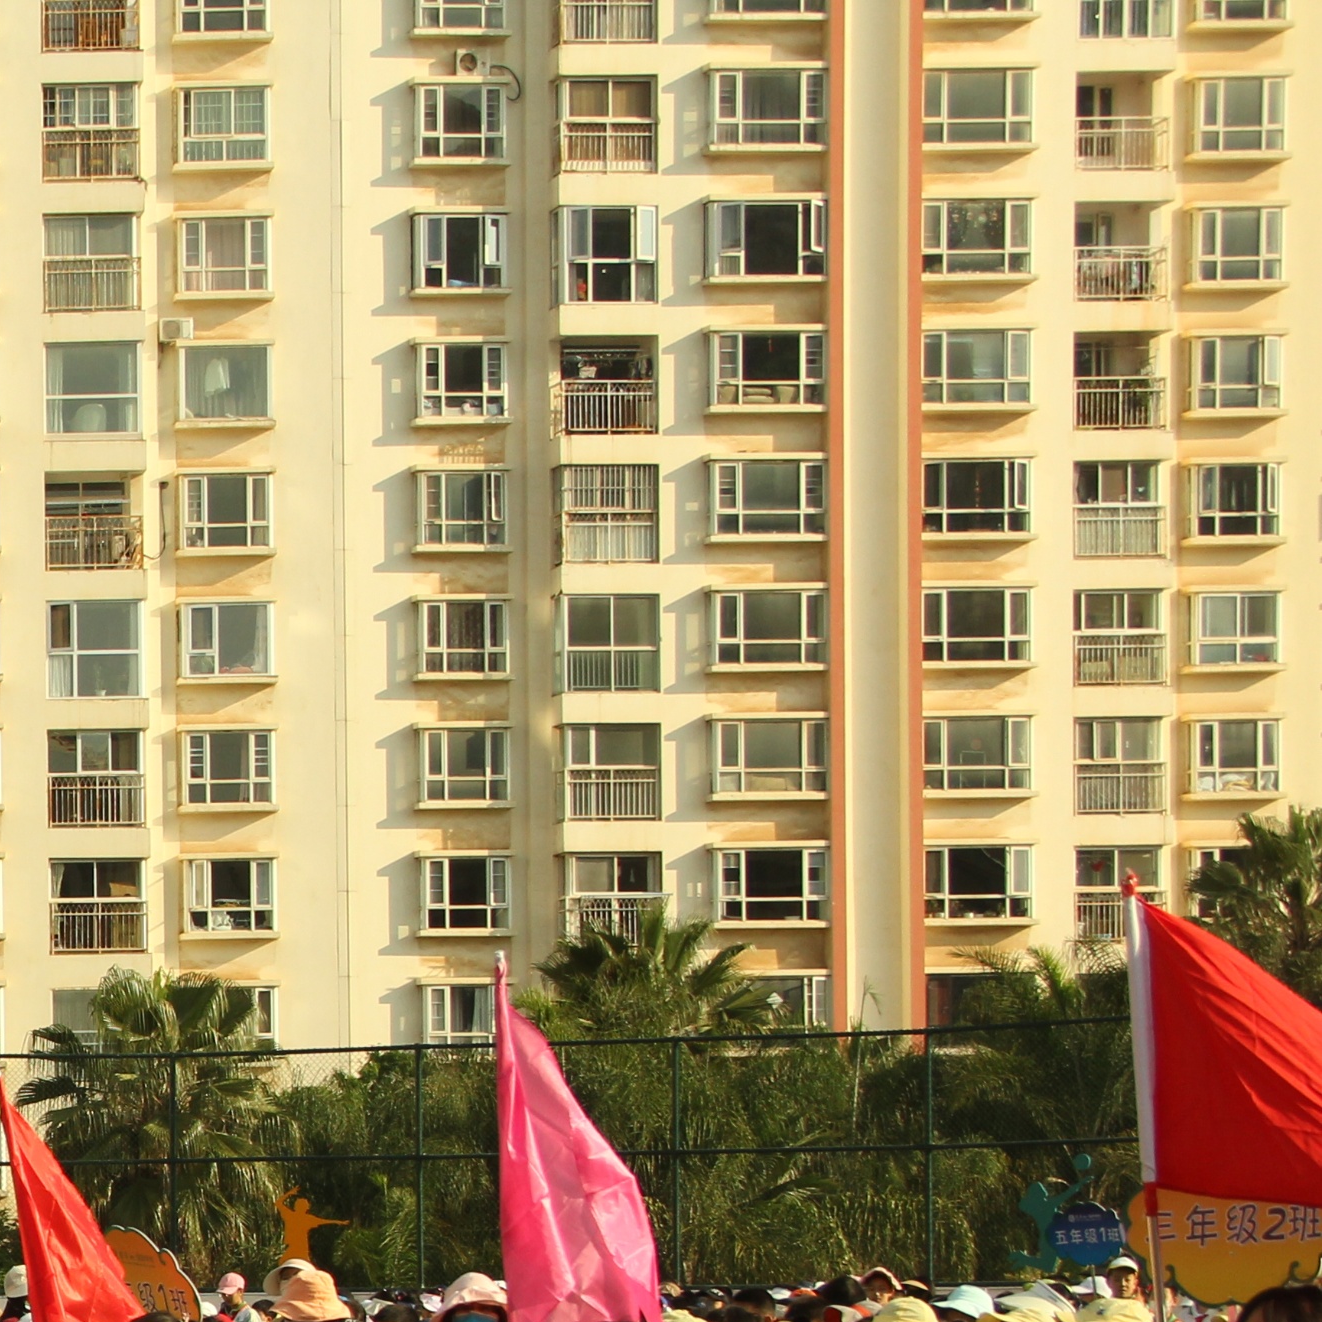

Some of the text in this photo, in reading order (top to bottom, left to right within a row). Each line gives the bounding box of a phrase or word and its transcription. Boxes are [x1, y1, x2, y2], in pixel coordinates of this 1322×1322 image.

[1055, 1227, 1120, 1244] 五年级1班
[125, 1283, 191, 1315] 级1班
